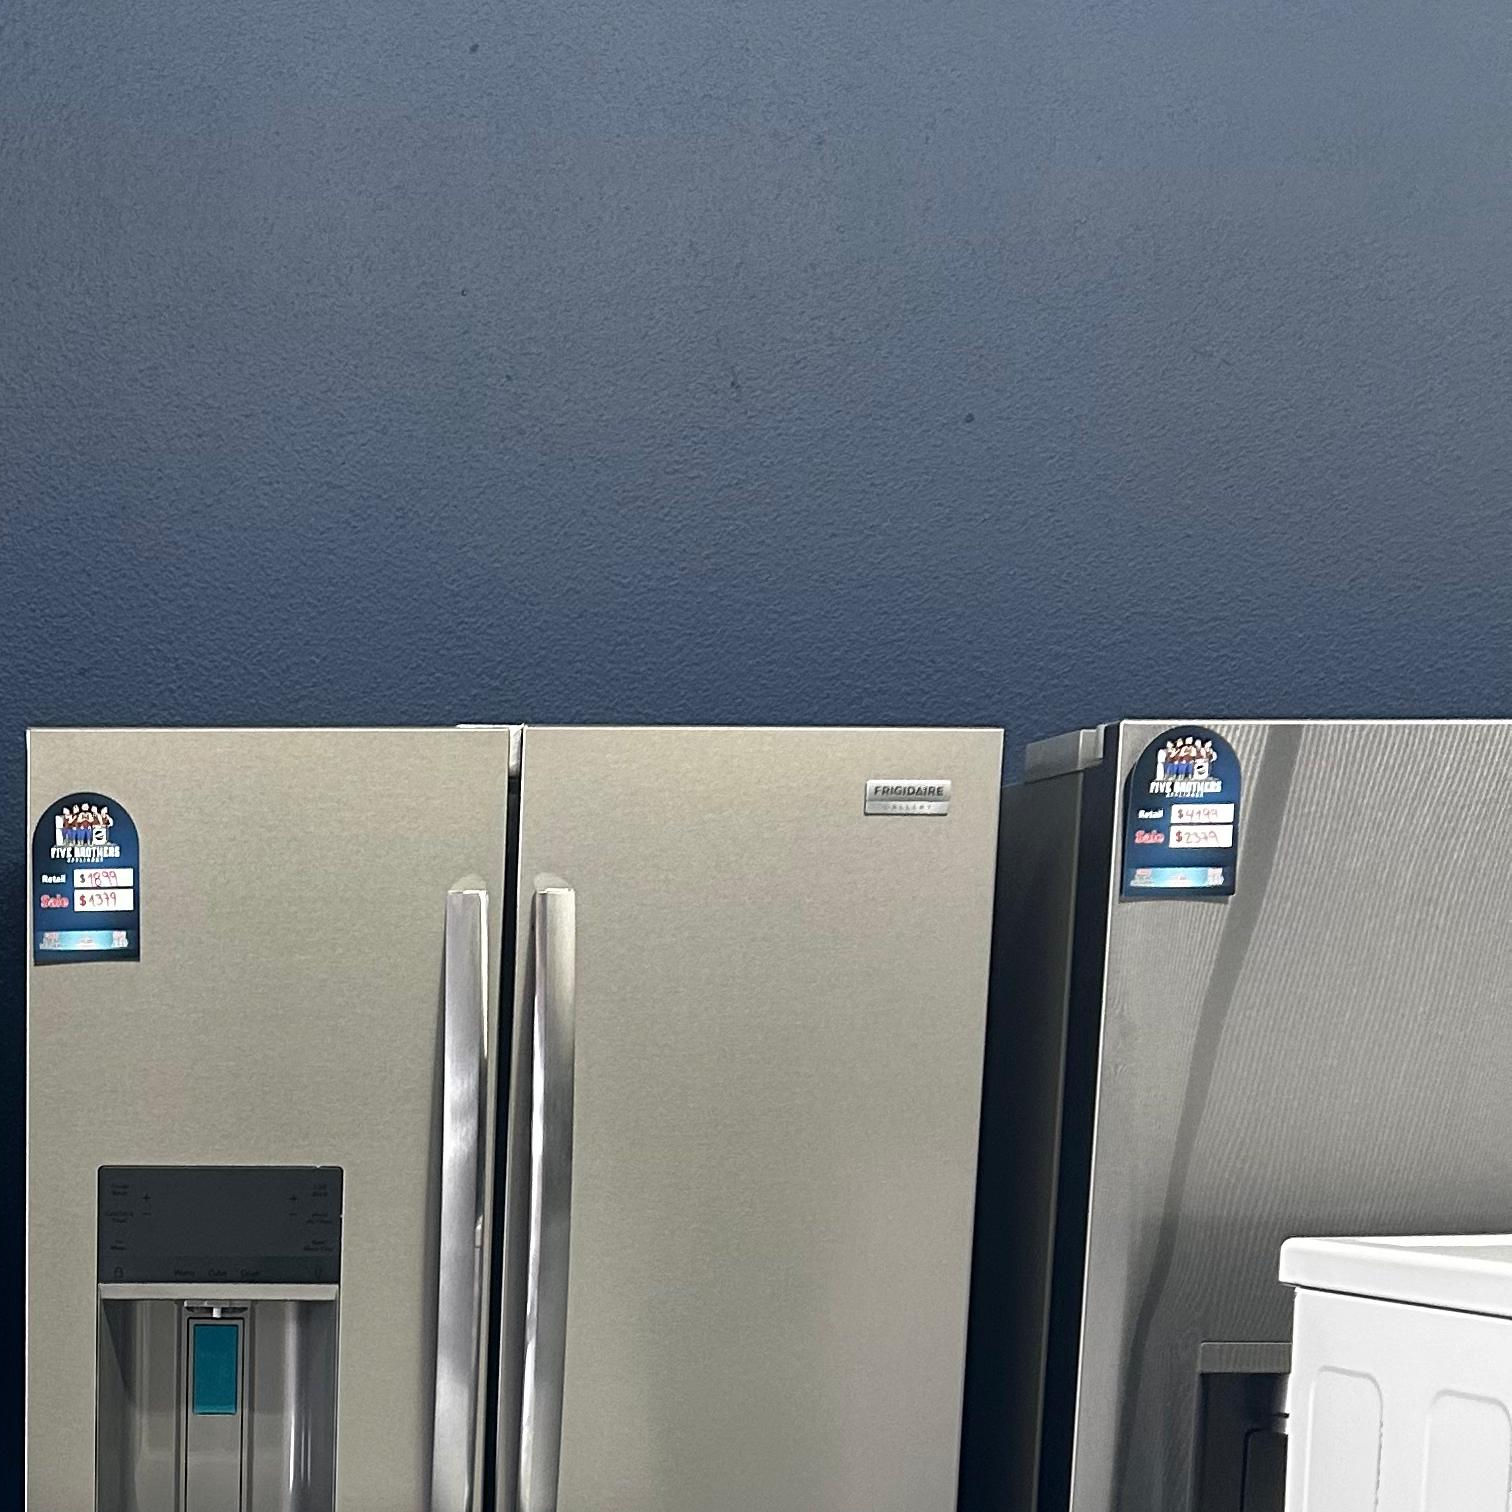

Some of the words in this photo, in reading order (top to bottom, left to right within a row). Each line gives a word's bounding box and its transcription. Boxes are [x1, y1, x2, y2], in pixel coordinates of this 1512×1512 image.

[874, 786, 944, 796] FRIGIDAIRE
[1134, 830, 1165, 844] Sale
[50, 846, 72, 859] FIVE
[74, 846, 120, 858] BROTHERS
[42, 874, 66, 884] Retail
[40, 894, 70, 908] Sale
